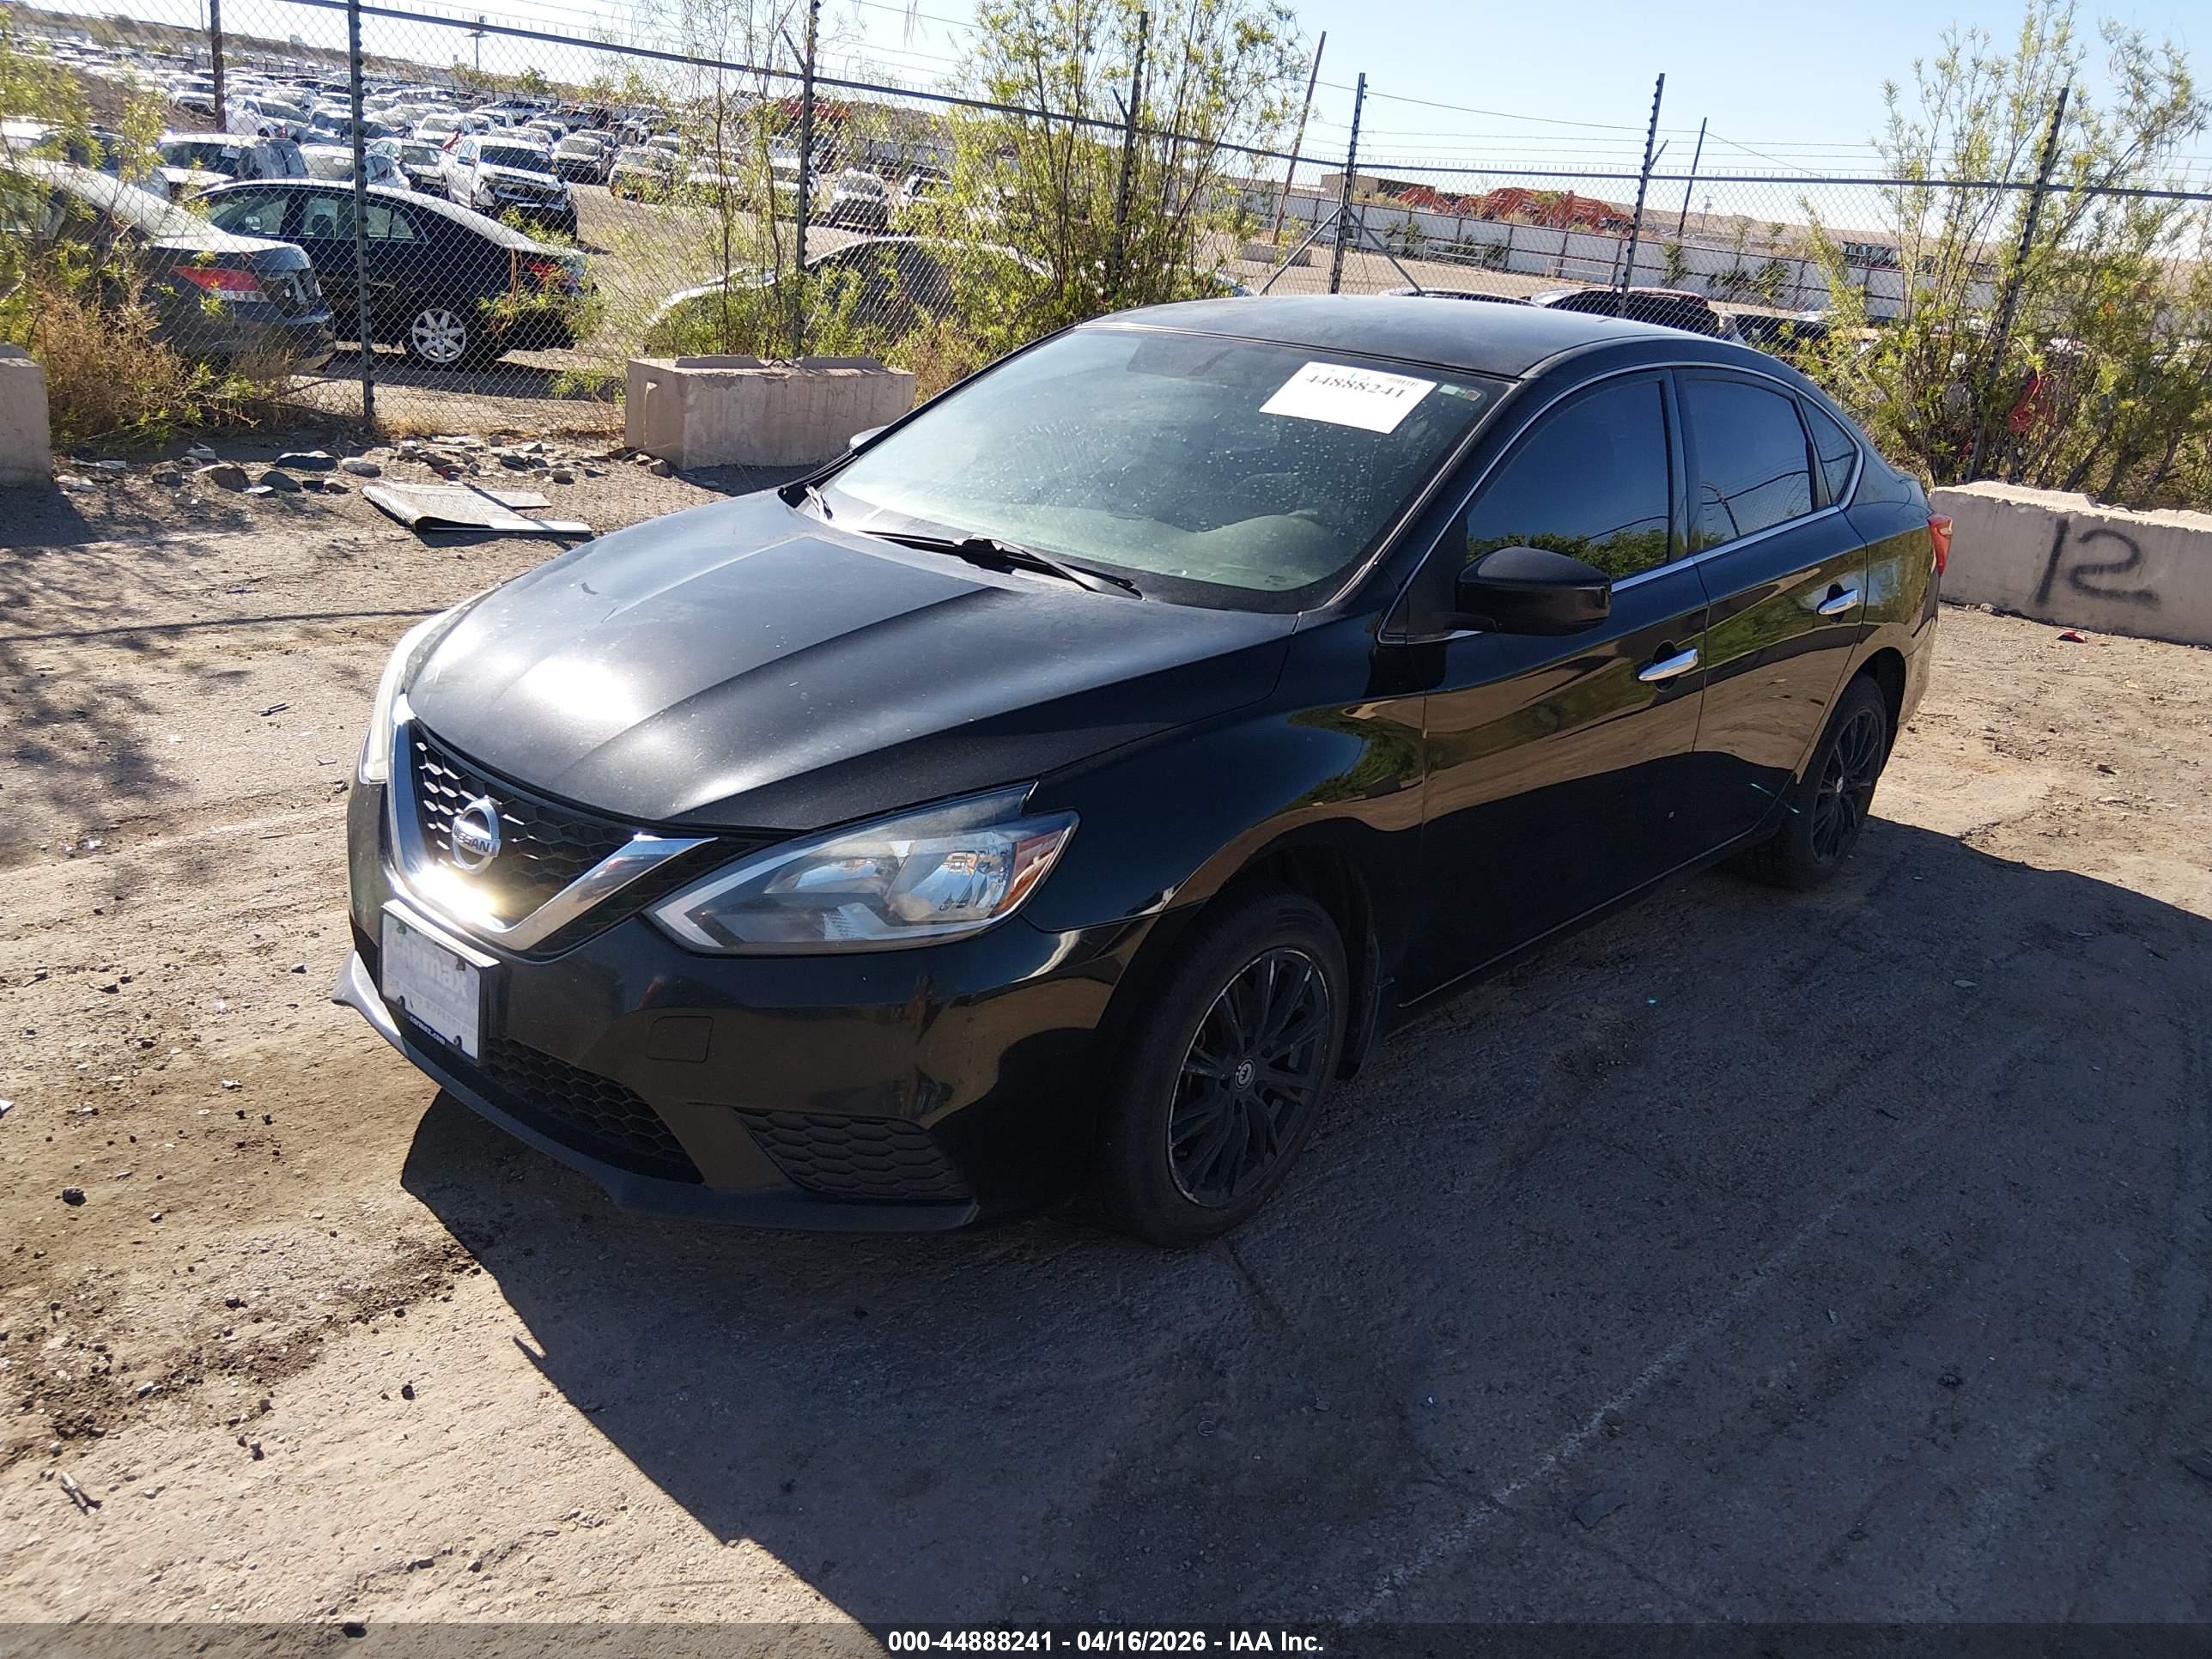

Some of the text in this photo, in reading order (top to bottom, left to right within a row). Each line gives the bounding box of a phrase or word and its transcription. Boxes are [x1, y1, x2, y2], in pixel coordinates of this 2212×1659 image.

[1305, 374, 1407, 398] 44888241
[2034, 515, 2160, 609] 12
[453, 823, 491, 853] NISSAN
